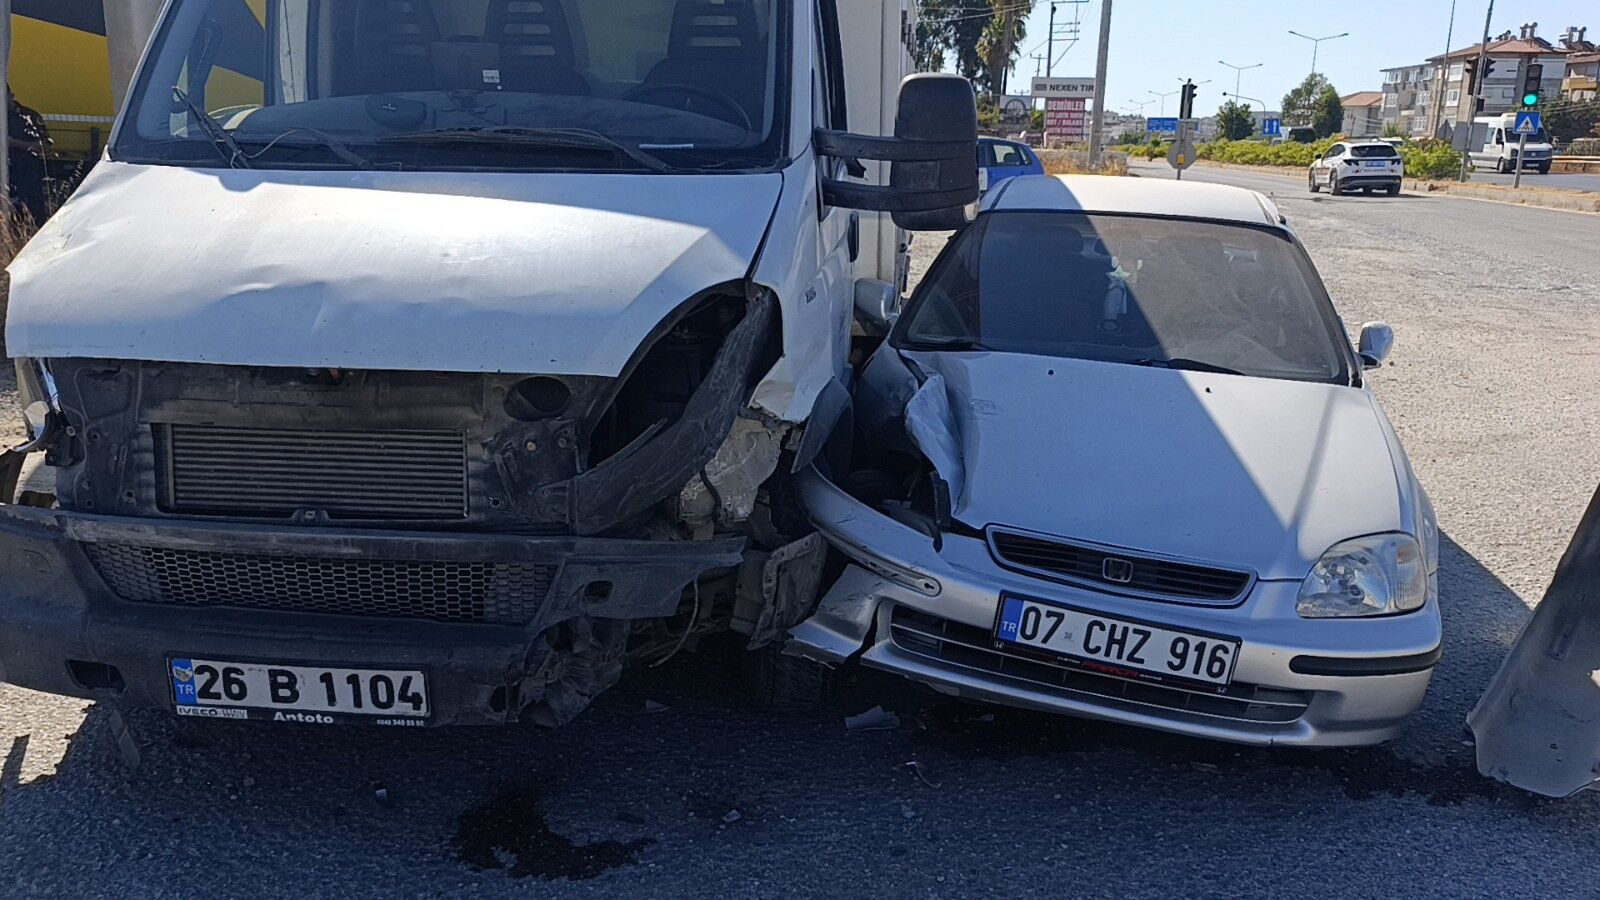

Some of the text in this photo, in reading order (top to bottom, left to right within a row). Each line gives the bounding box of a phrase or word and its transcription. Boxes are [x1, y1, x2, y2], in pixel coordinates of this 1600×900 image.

[1049, 84, 1095, 92] NEXEN TIR
[1002, 620, 1016, 633] TR
[1019, 605, 1065, 645] 07
[1083, 620, 1152, 665] CHZ
[1166, 636, 1230, 679] 916
[177, 664, 424, 711] TR 26 B 1104
[178, 707, 218, 716] IVECO
[273, 711, 334, 724] Antoto
